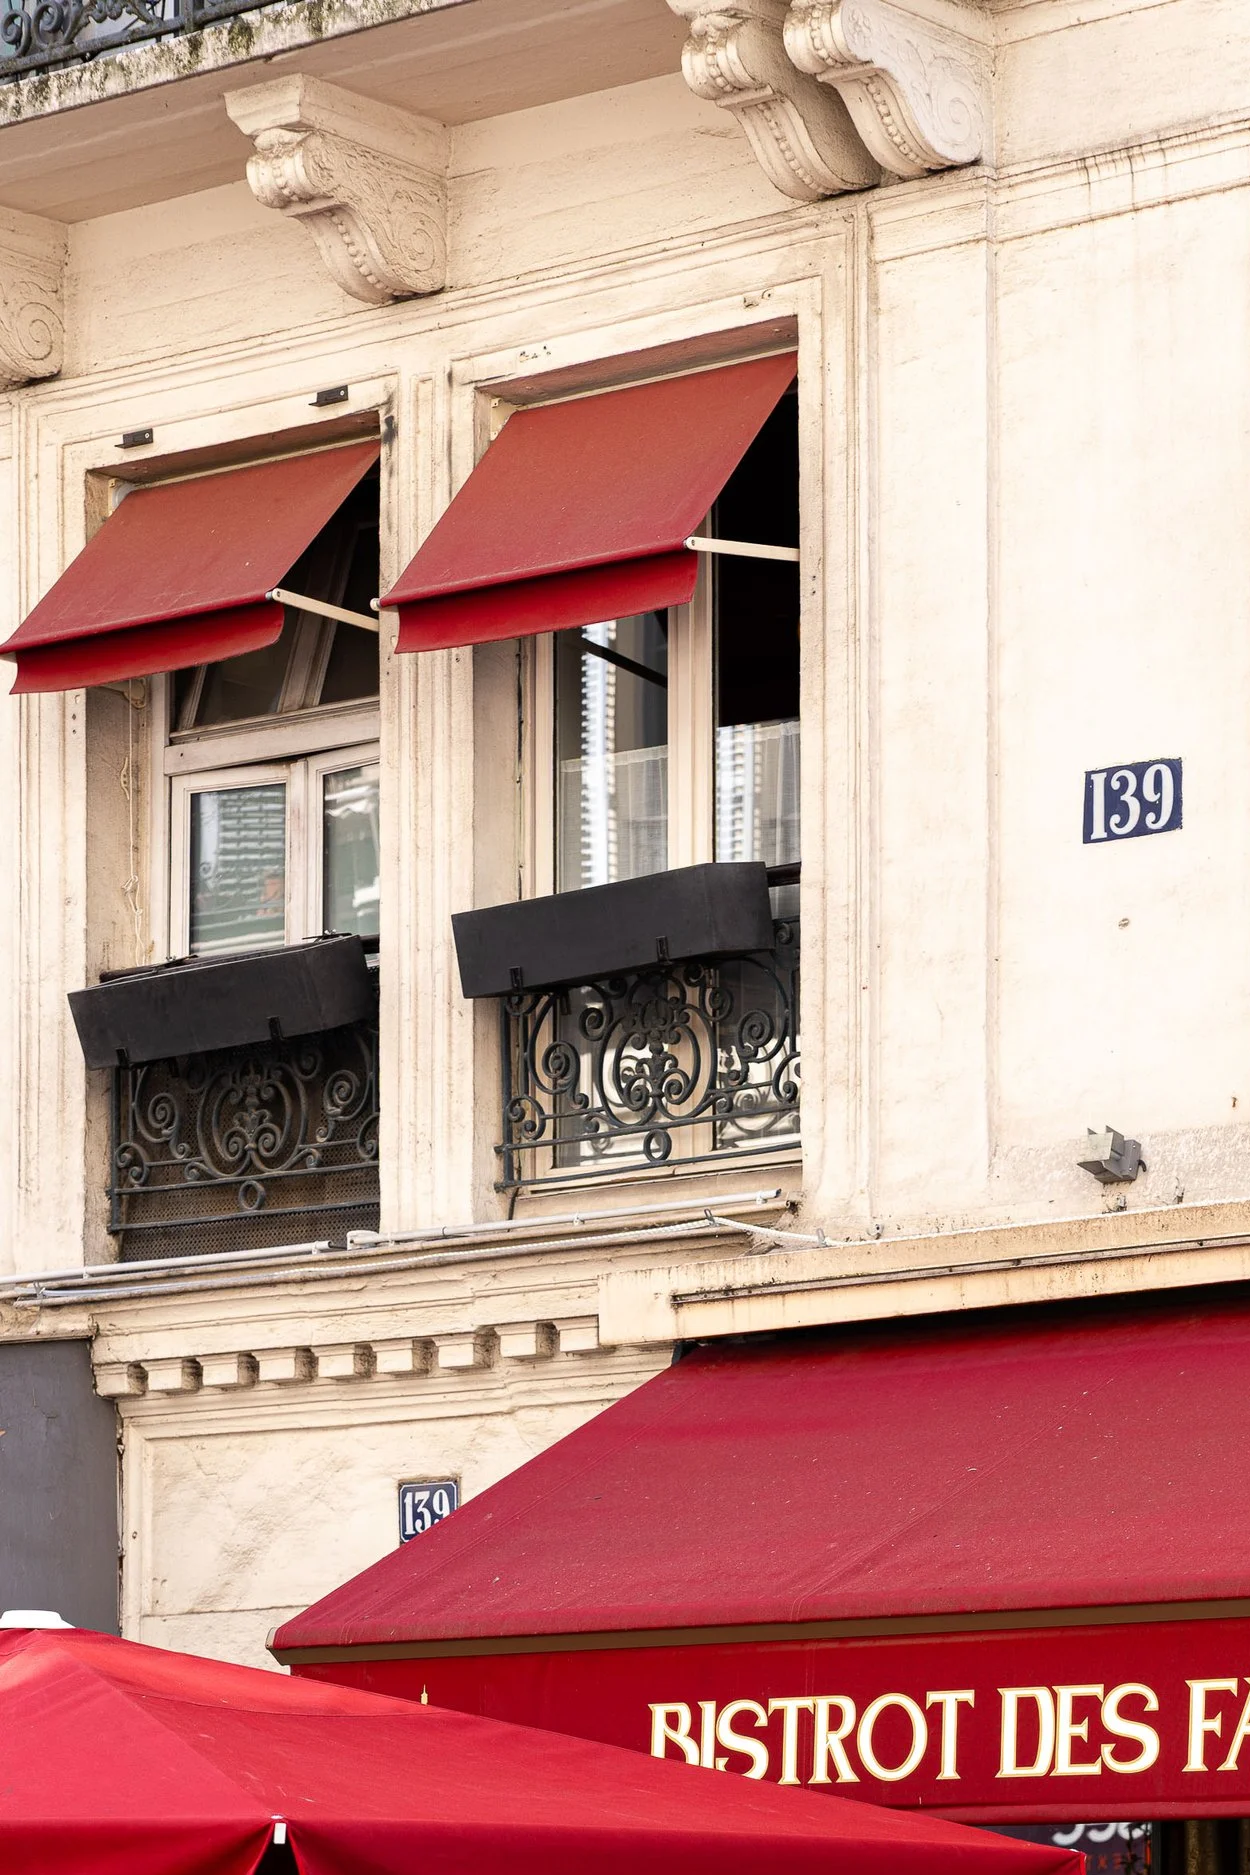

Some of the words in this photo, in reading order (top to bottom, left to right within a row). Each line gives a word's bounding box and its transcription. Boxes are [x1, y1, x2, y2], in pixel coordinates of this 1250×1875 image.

[1090, 763, 1175, 840] 139
[404, 1488, 451, 1535] 139
[648, 1689, 975, 1785] BISTROT
[995, 1683, 1160, 1778] DES
